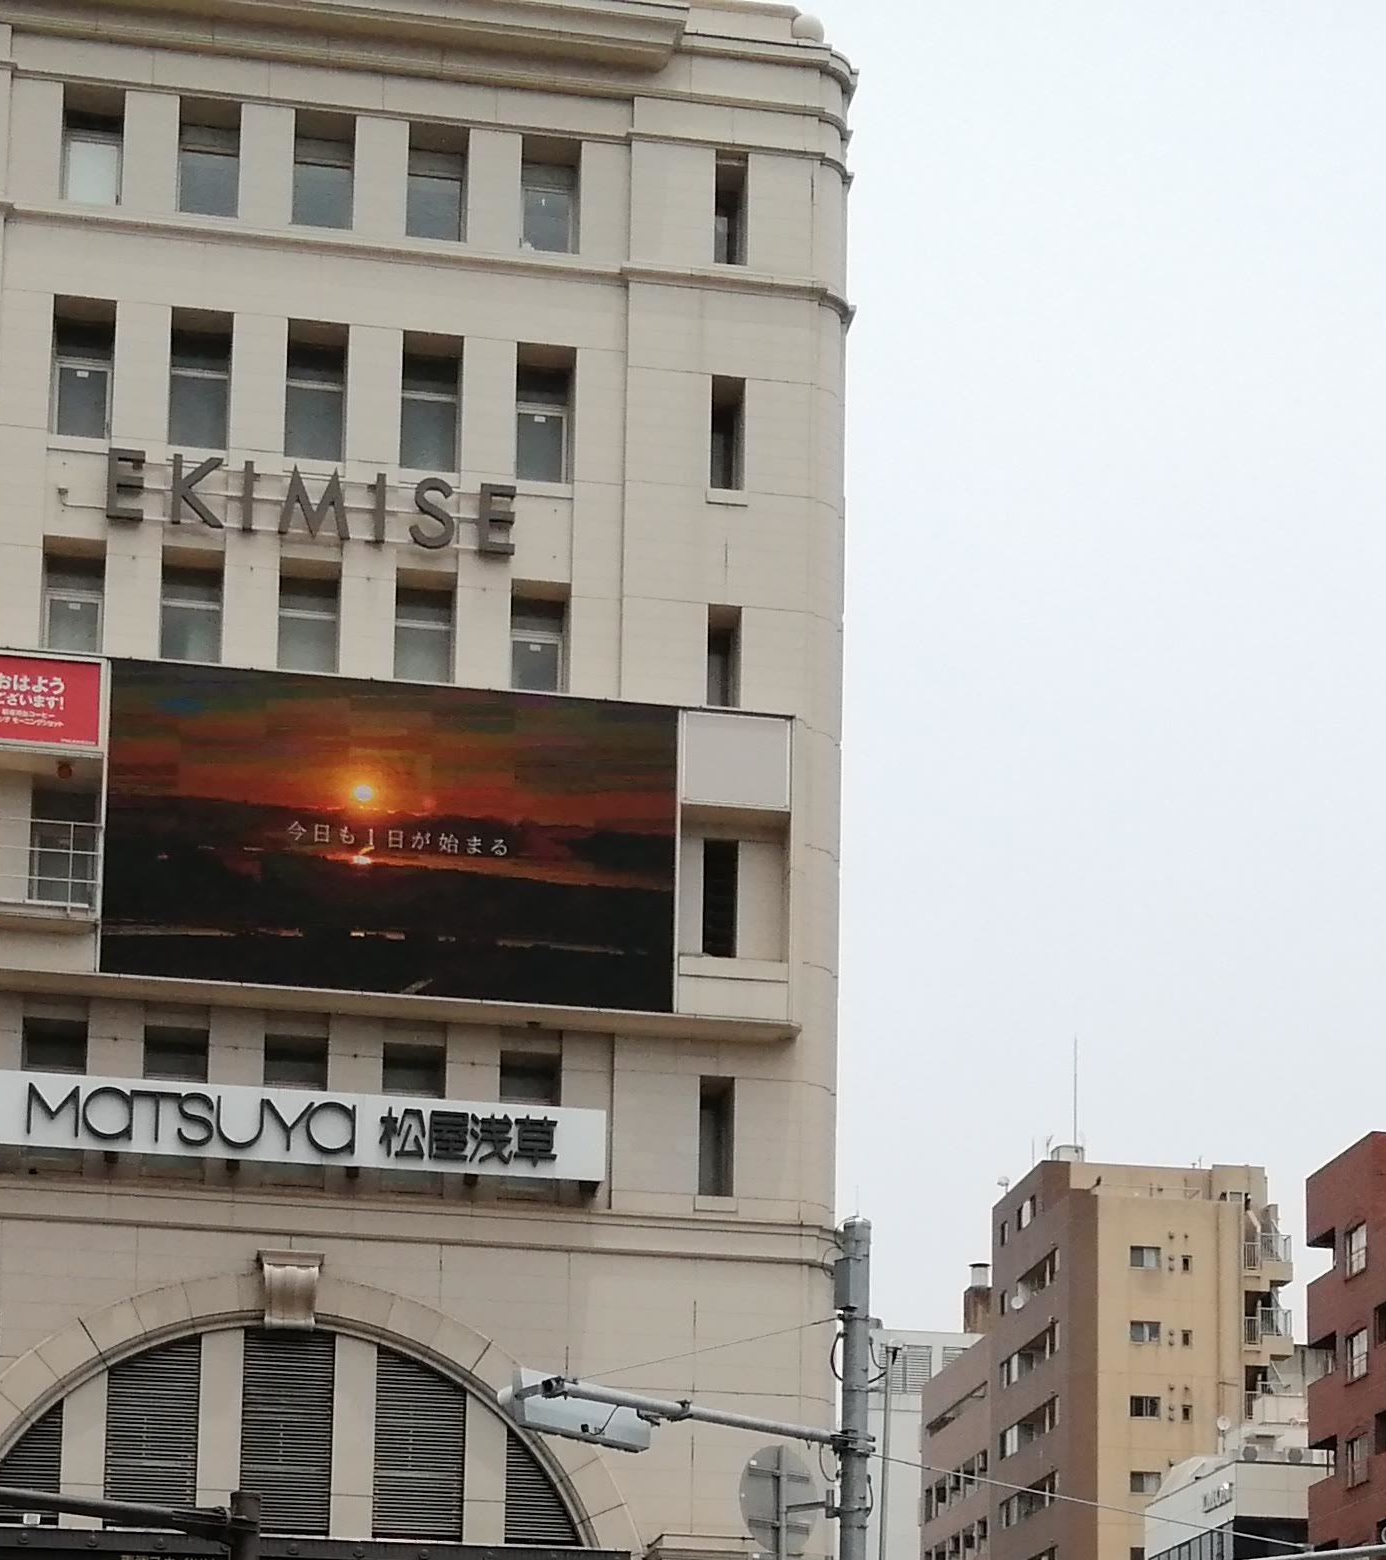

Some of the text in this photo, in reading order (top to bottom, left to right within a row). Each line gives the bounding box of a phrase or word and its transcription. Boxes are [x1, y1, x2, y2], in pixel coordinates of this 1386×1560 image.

[105, 447, 518, 557] EKIMISE
[287, 820, 509, 857] 今日も1日が始まる
[379, 1105, 558, 1166] 松屋浅草
